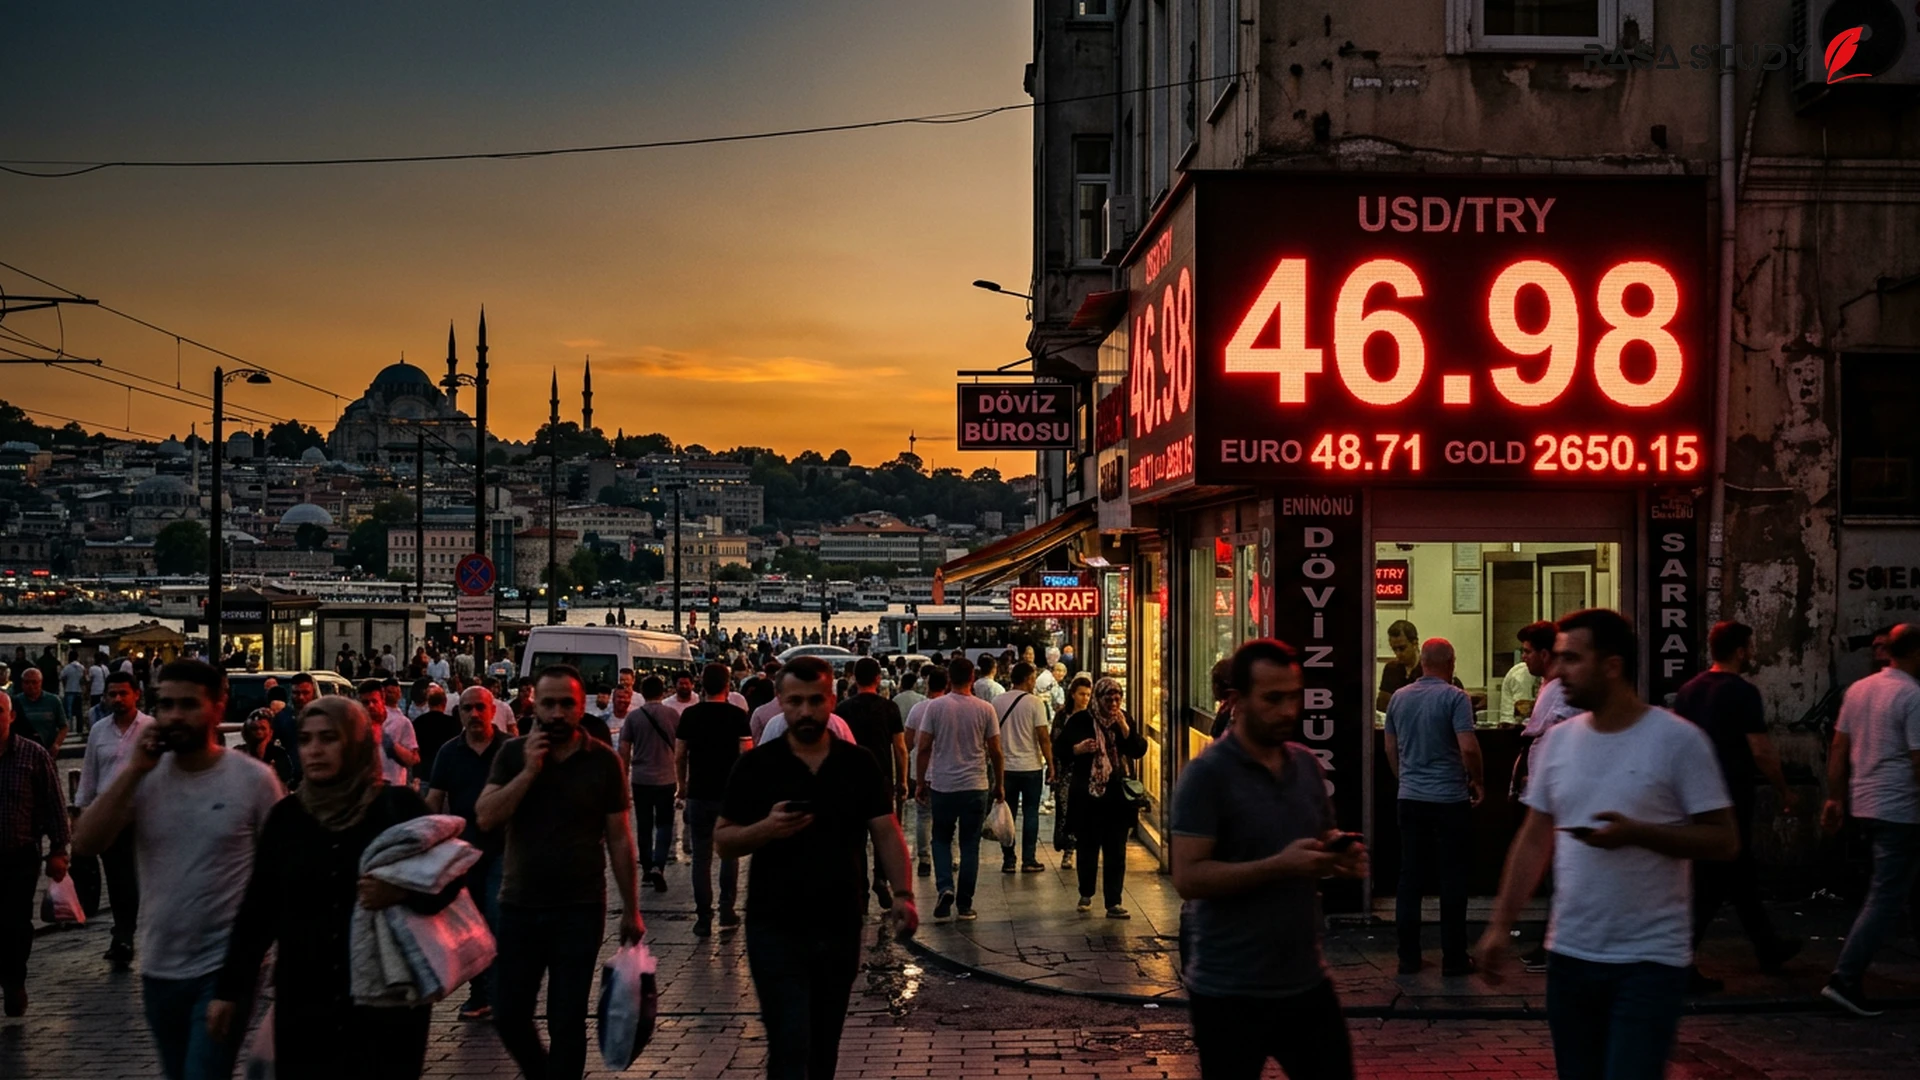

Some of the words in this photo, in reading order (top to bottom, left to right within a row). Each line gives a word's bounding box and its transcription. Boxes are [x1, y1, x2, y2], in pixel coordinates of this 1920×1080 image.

[1358, 196, 1557, 234] USD/TRY
[1130, 266, 1193, 438] 46.98
[1224, 258, 1684, 408] 46.98
[978, 390, 1056, 414] DÖVİZ
[964, 418, 1070, 442] BÜROSU
[1221, 439, 1302, 464] EURO
[1310, 433, 1422, 472] 48.71
[1444, 440, 1526, 465] GOLD
[1533, 434, 1700, 472] 2650.15
[1014, 592, 1095, 611] SARRAF
[1301, 526, 1336, 668] DÖVİZ
[1659, 532, 1688, 678] SARRAF
